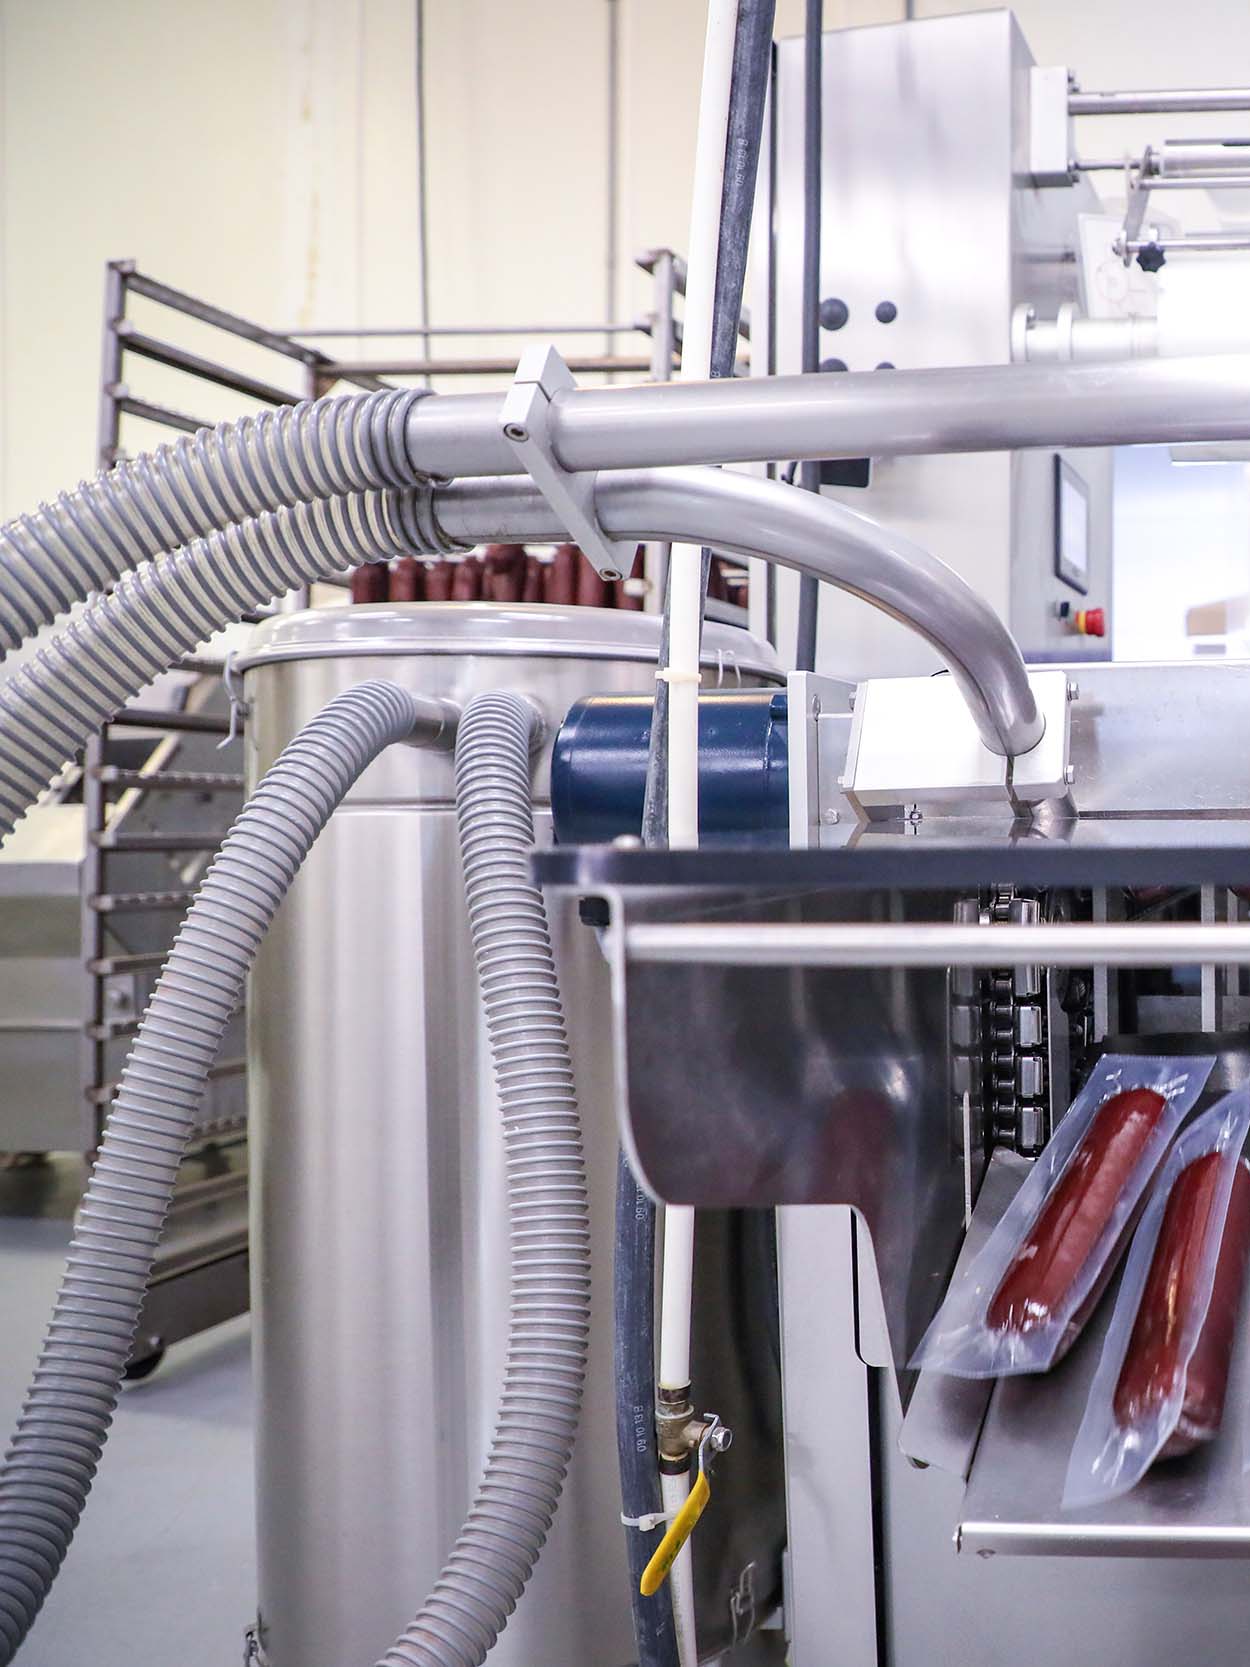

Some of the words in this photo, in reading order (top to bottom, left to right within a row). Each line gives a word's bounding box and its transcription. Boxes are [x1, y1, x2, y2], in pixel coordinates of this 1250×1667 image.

[635, 1207, 645, 1220] 09
[634, 1414, 644, 1424] 13
[635, 1427, 646, 1437] 10
[636, 1439, 647, 1452] 09
